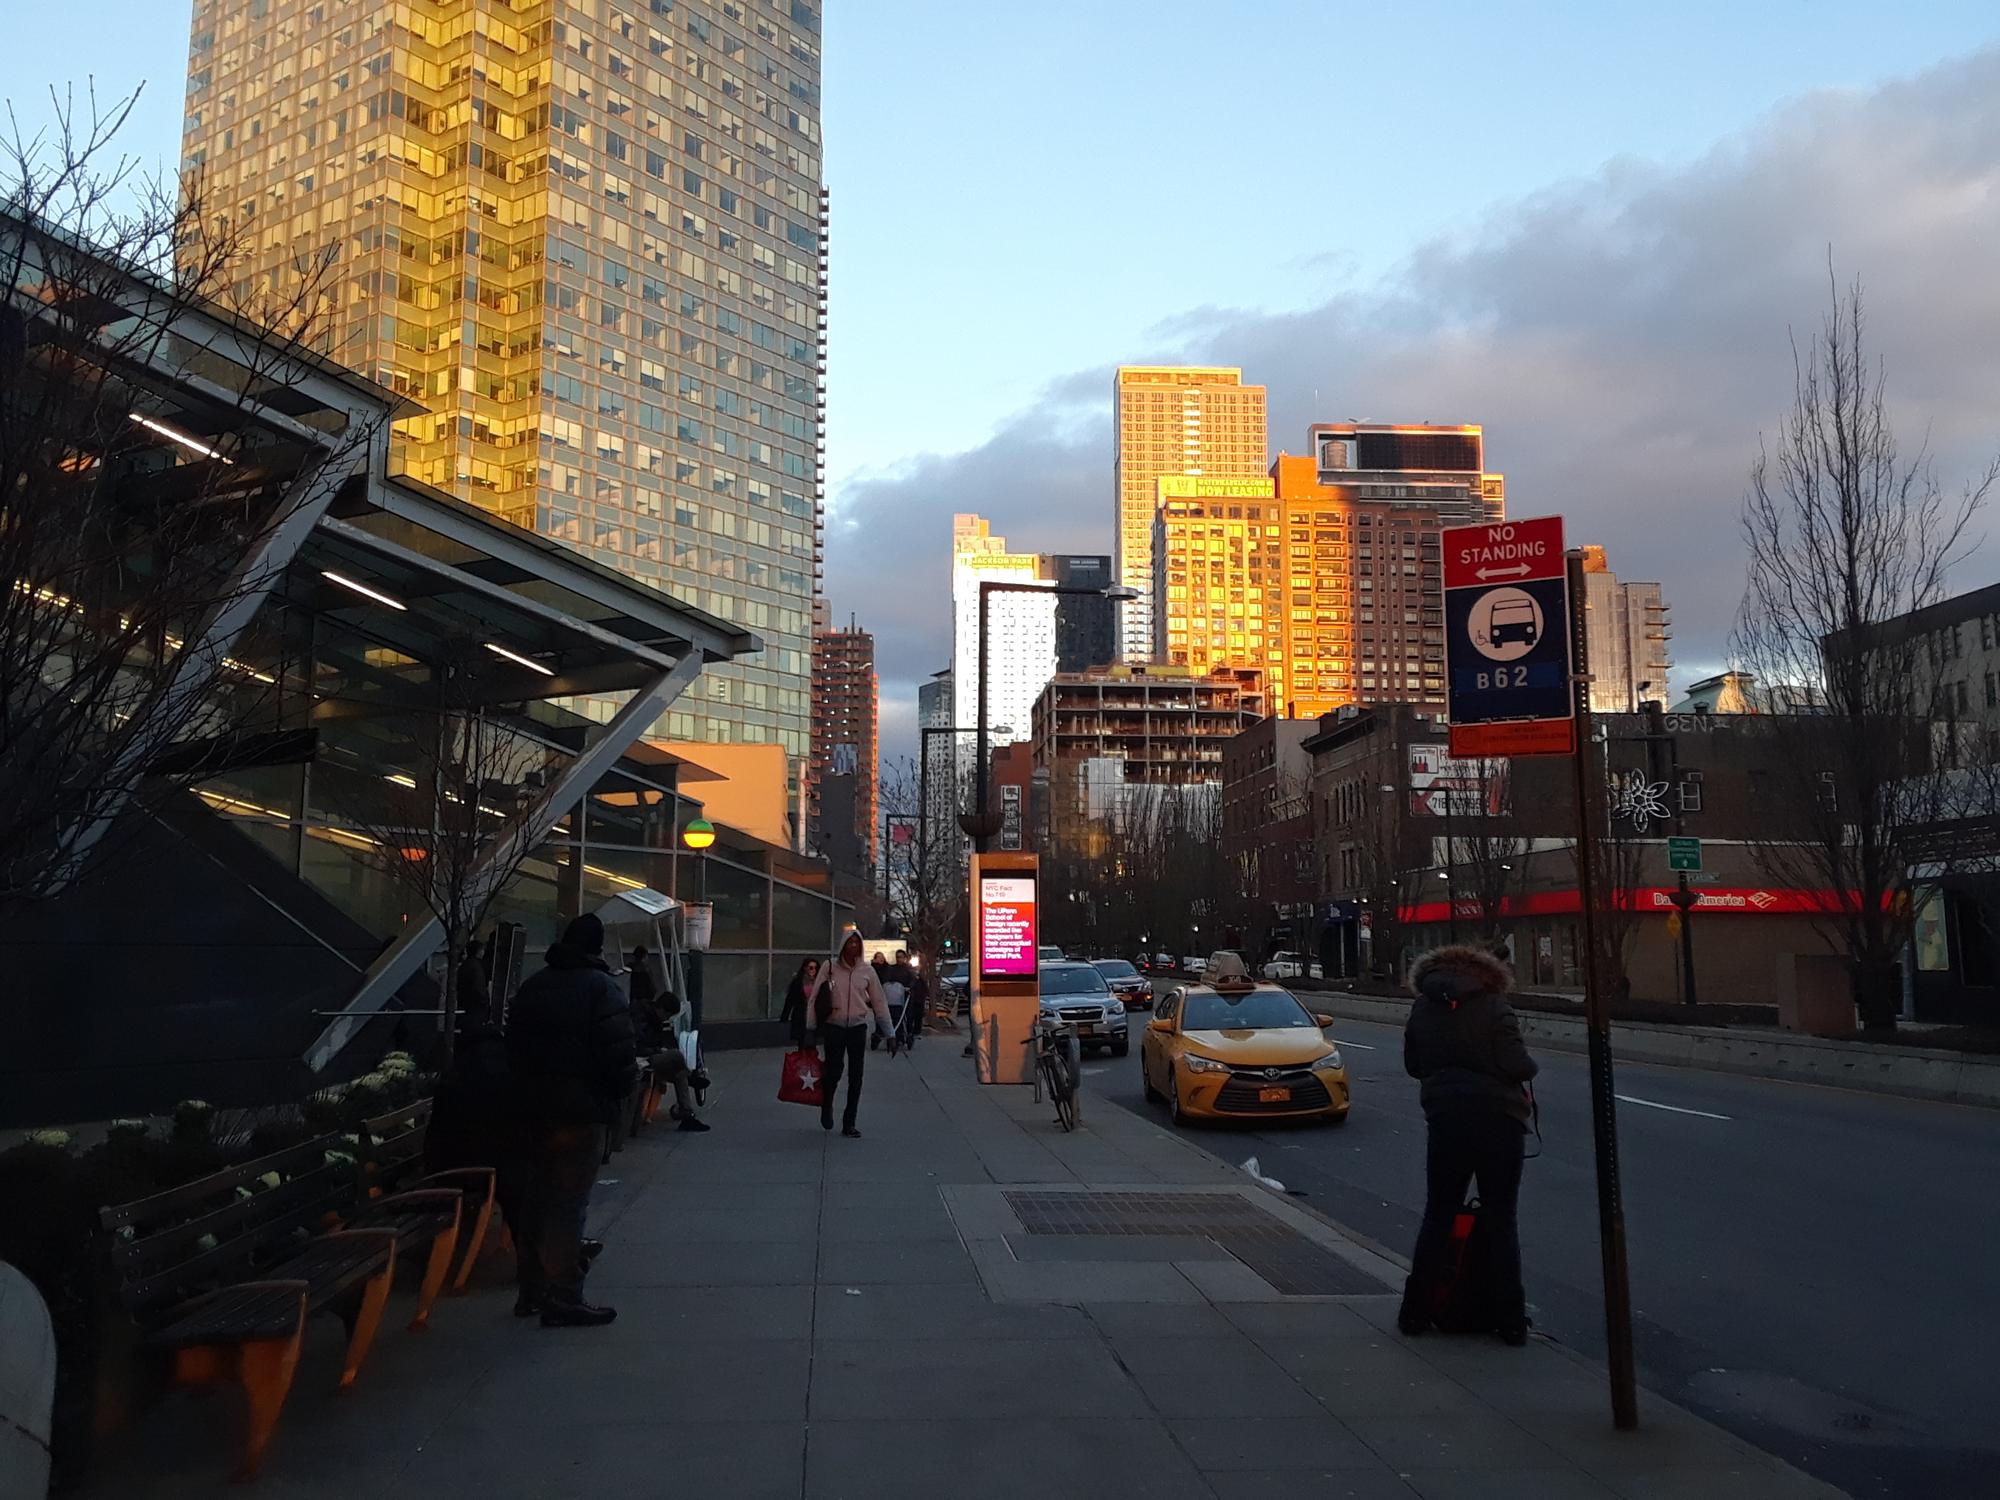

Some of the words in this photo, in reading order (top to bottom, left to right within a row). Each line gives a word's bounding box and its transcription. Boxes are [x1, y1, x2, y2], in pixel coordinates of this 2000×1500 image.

[1197, 485, 1224, 497] NOW
[1226, 486, 1273, 497] LEASING
[1488, 526, 1515, 543] NO
[1460, 541, 1546, 564] STANDING
[1476, 666, 1528, 689] B62
[1697, 892, 1745, 906] America
[1006, 920, 1030, 928] recently
